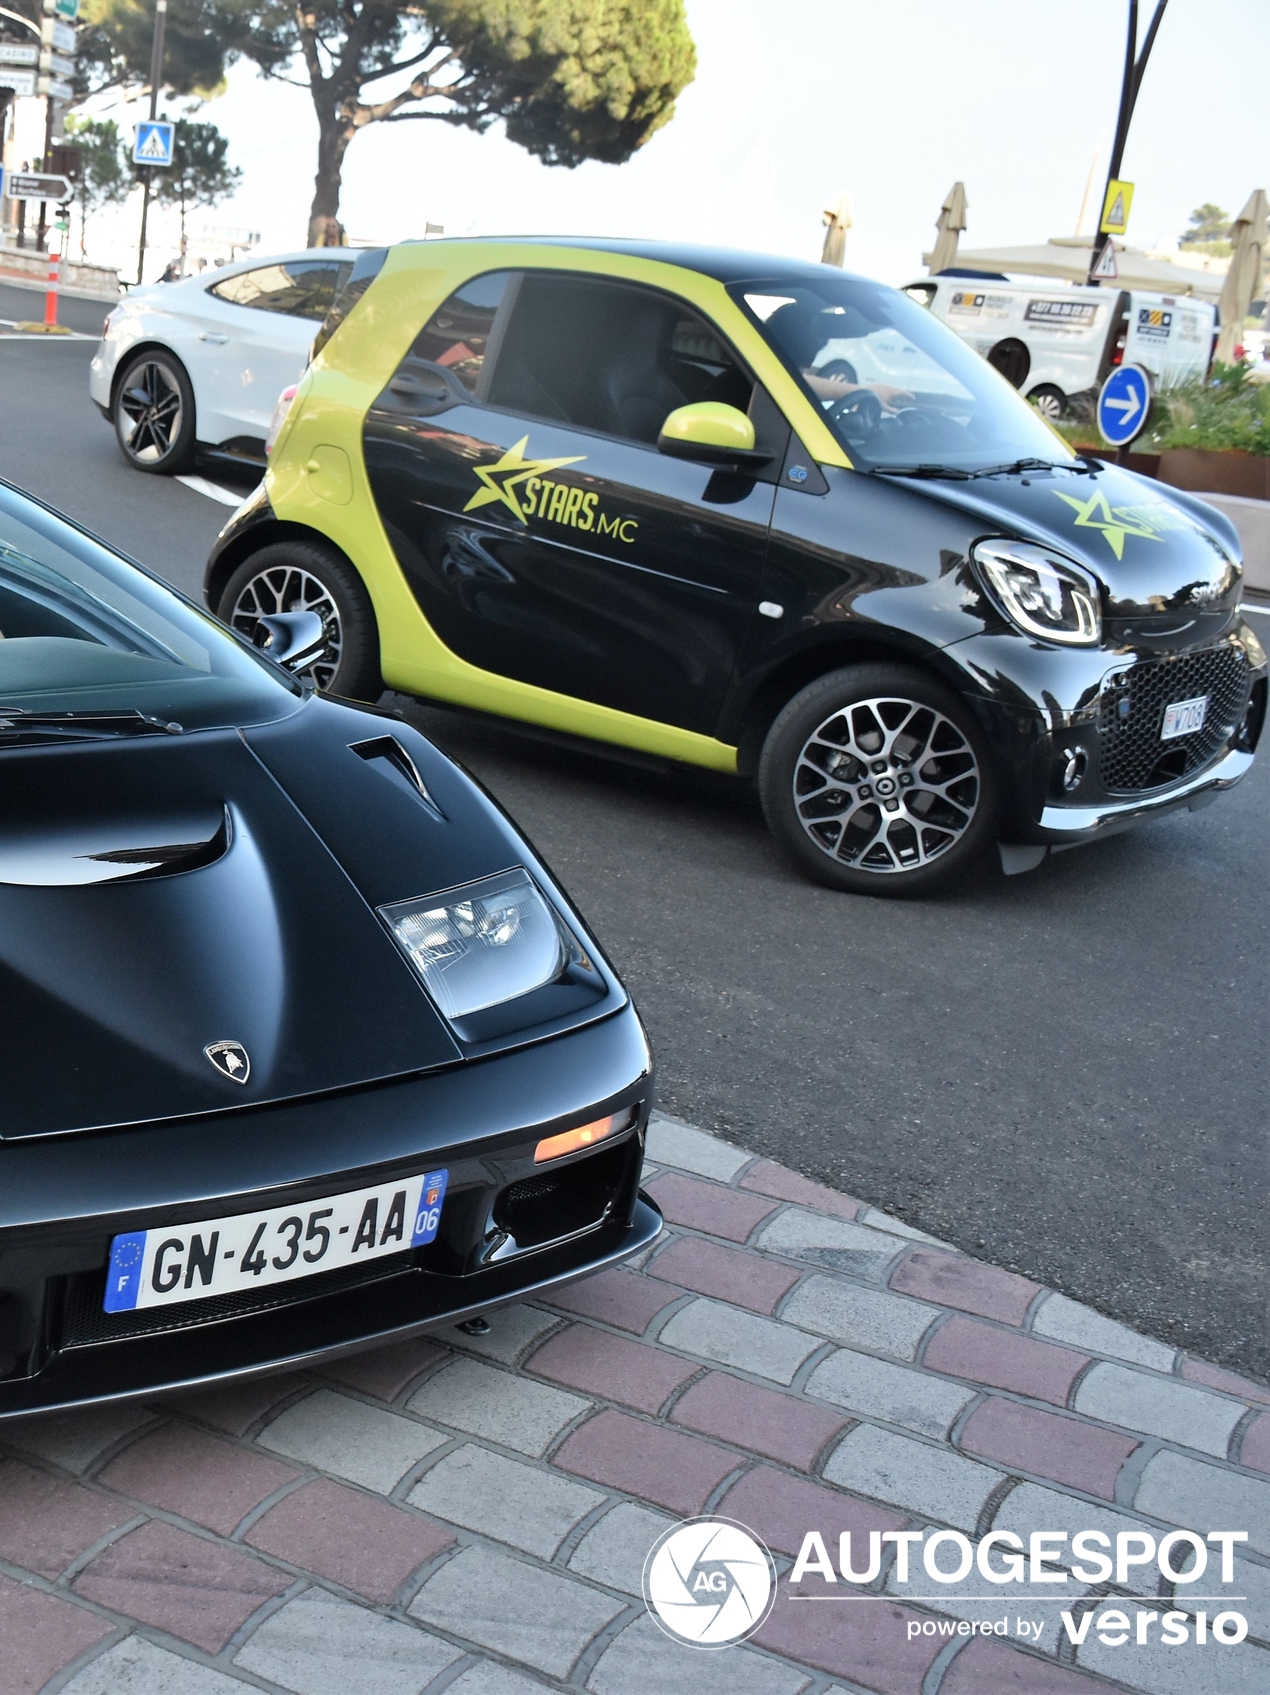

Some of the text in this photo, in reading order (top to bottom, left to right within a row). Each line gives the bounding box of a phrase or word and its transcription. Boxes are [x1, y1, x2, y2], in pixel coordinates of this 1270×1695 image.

[521, 477, 639, 543] STARS.MC
[151, 1190, 407, 1293] GN-435-AA
[415, 1207, 439, 1235] 06
[117, 1275, 129, 1292] F
